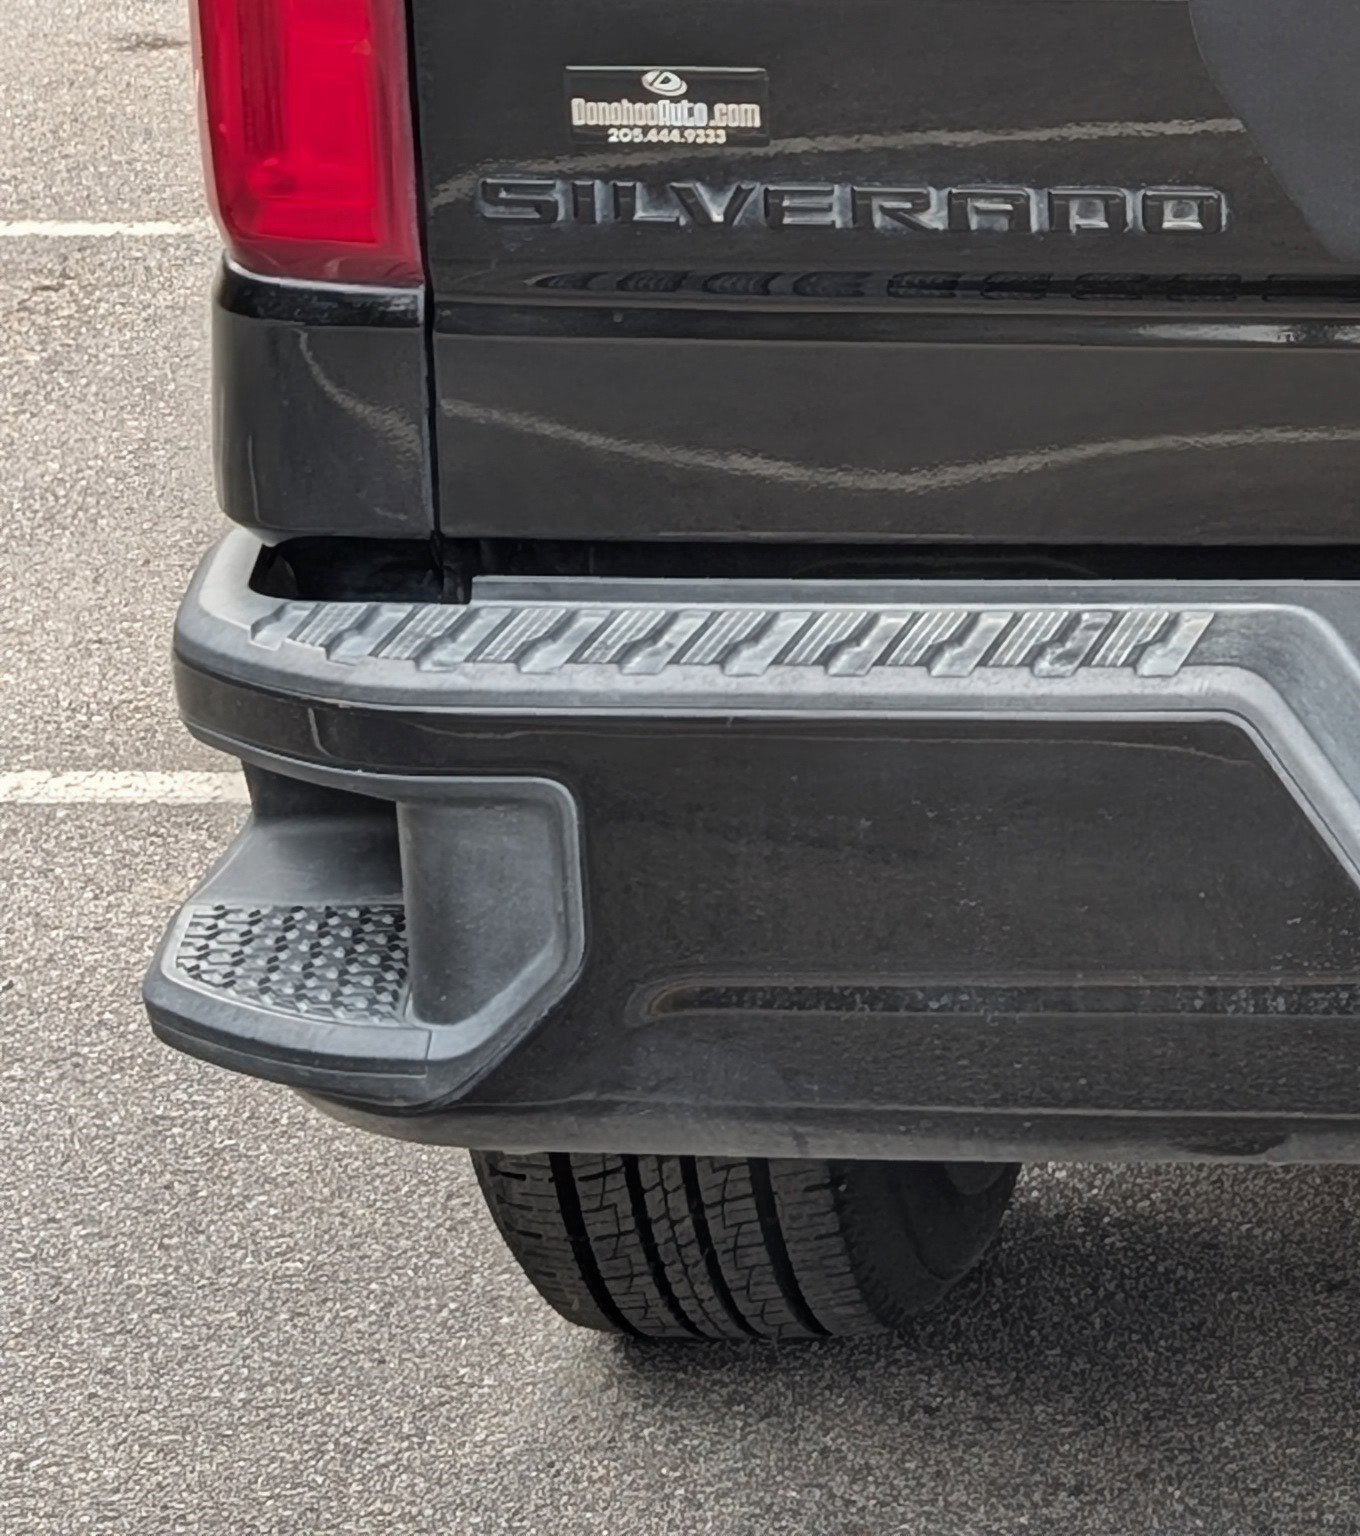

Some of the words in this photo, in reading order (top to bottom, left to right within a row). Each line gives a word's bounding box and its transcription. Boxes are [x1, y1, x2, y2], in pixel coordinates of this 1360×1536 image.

[571, 98, 761, 127] DonohooAuto.com
[607, 128, 727, 143] 205.444.9333
[478, 178, 1228, 233] SILVERADO
